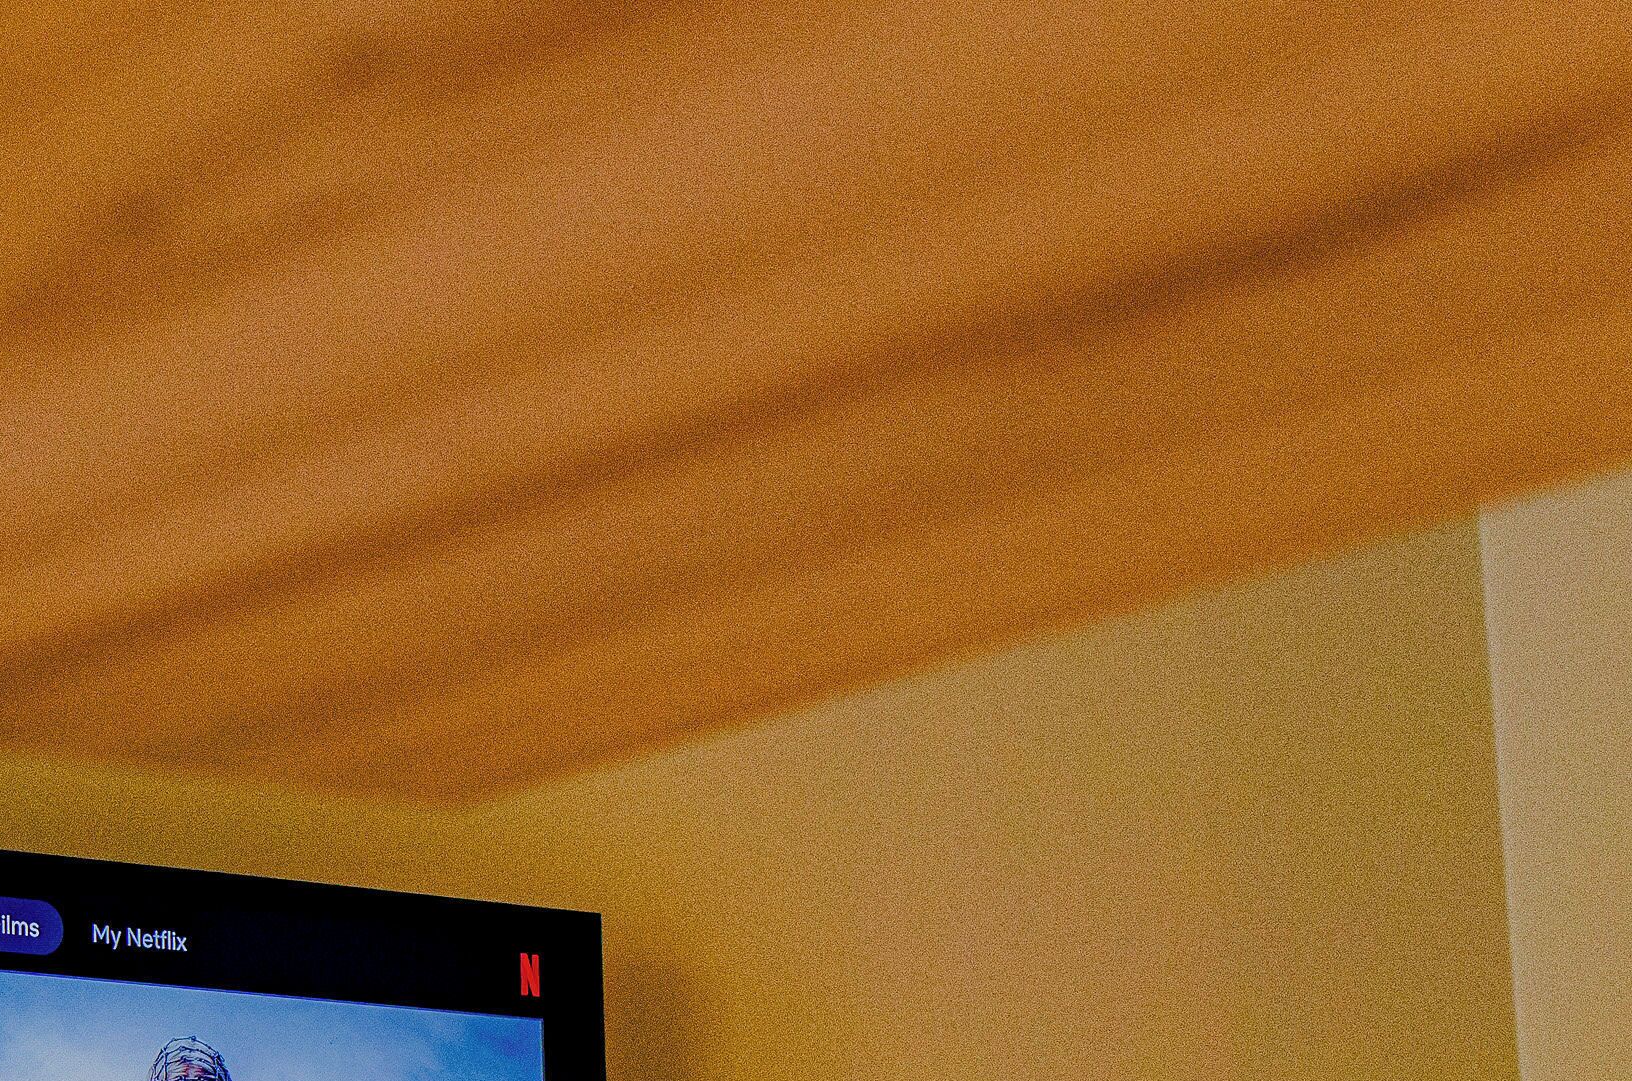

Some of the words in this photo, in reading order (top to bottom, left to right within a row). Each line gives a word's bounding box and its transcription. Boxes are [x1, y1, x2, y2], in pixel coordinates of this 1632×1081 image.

[92, 923, 121, 951] My
[127, 927, 188, 953] Netflix
[520, 952, 540, 997] N
